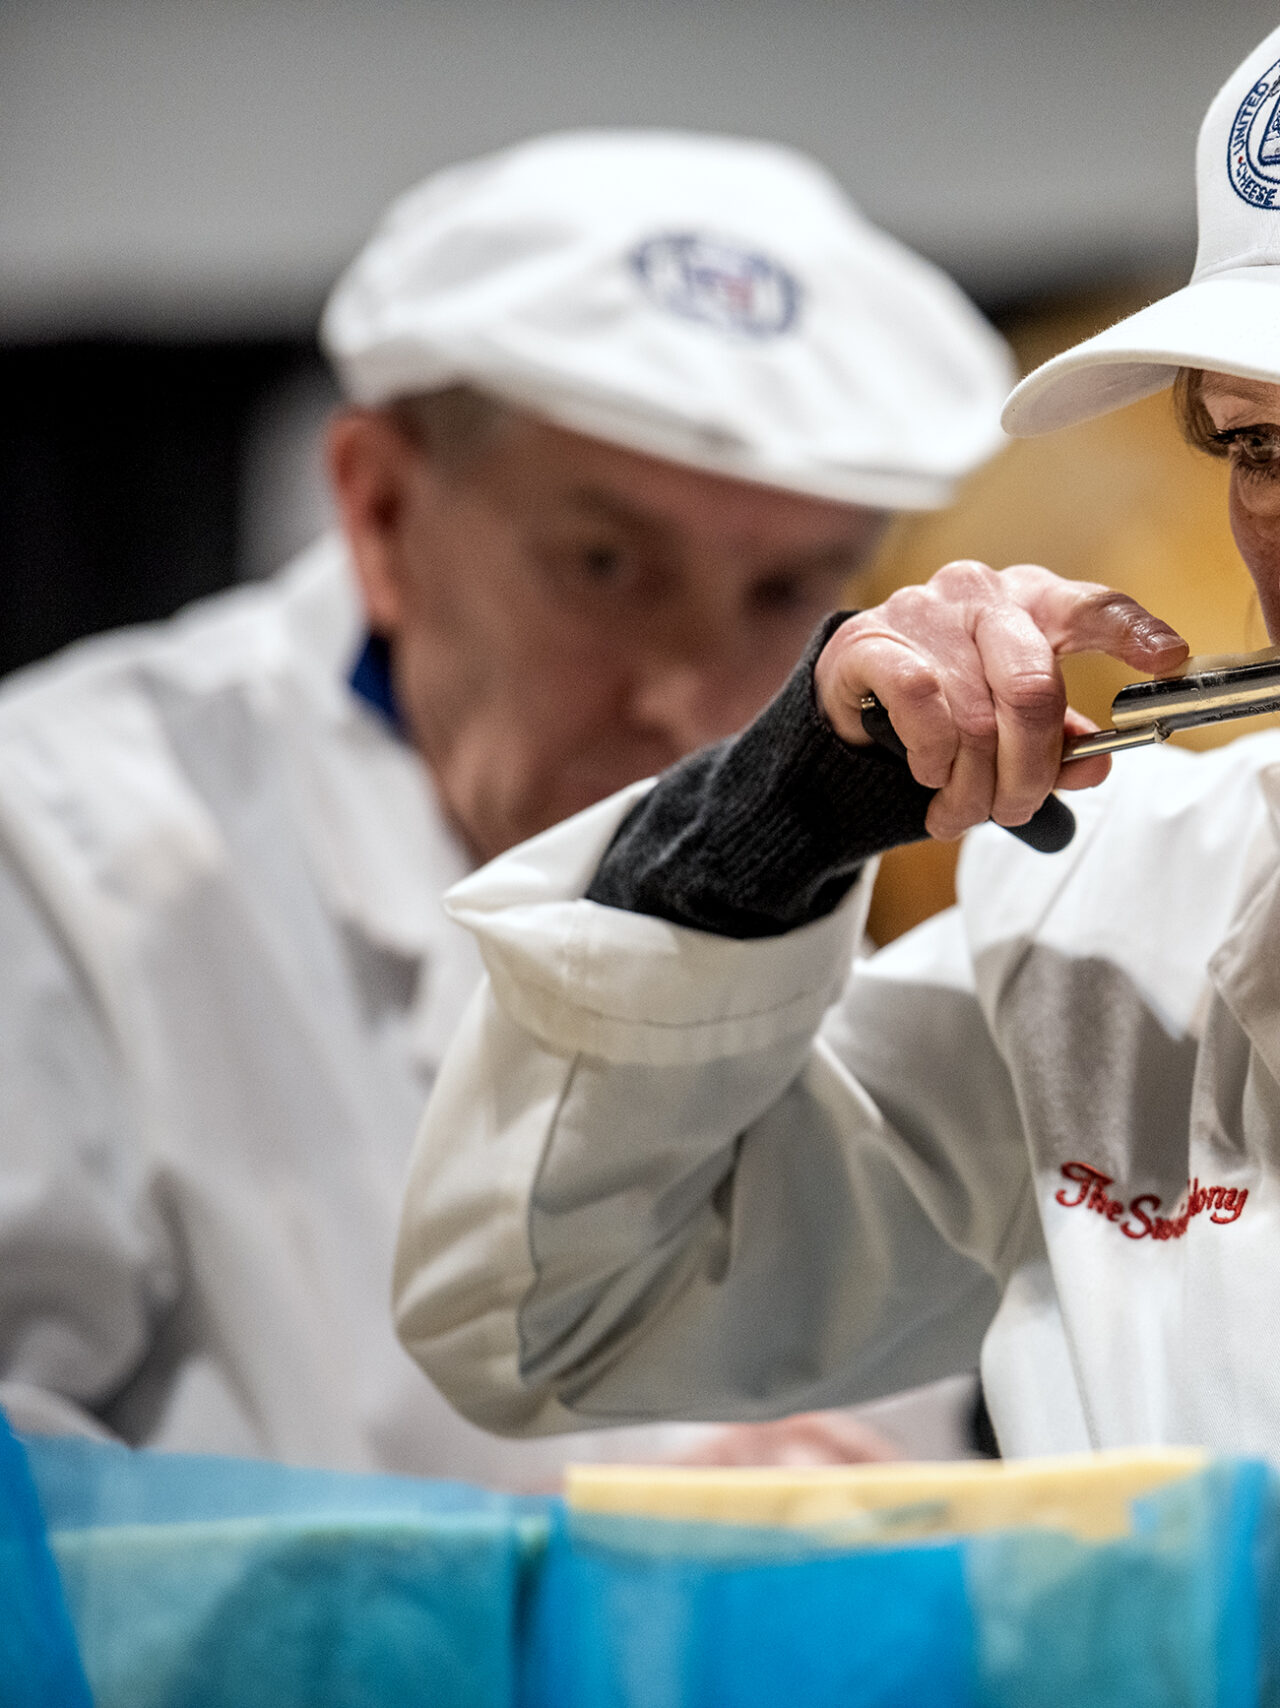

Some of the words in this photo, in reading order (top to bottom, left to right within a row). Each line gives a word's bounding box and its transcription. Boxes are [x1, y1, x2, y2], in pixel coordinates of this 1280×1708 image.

[1233, 82, 1269, 156] UNITED
[1234, 162, 1277, 206] CHEESE
[1055, 1161, 1124, 1222] The
